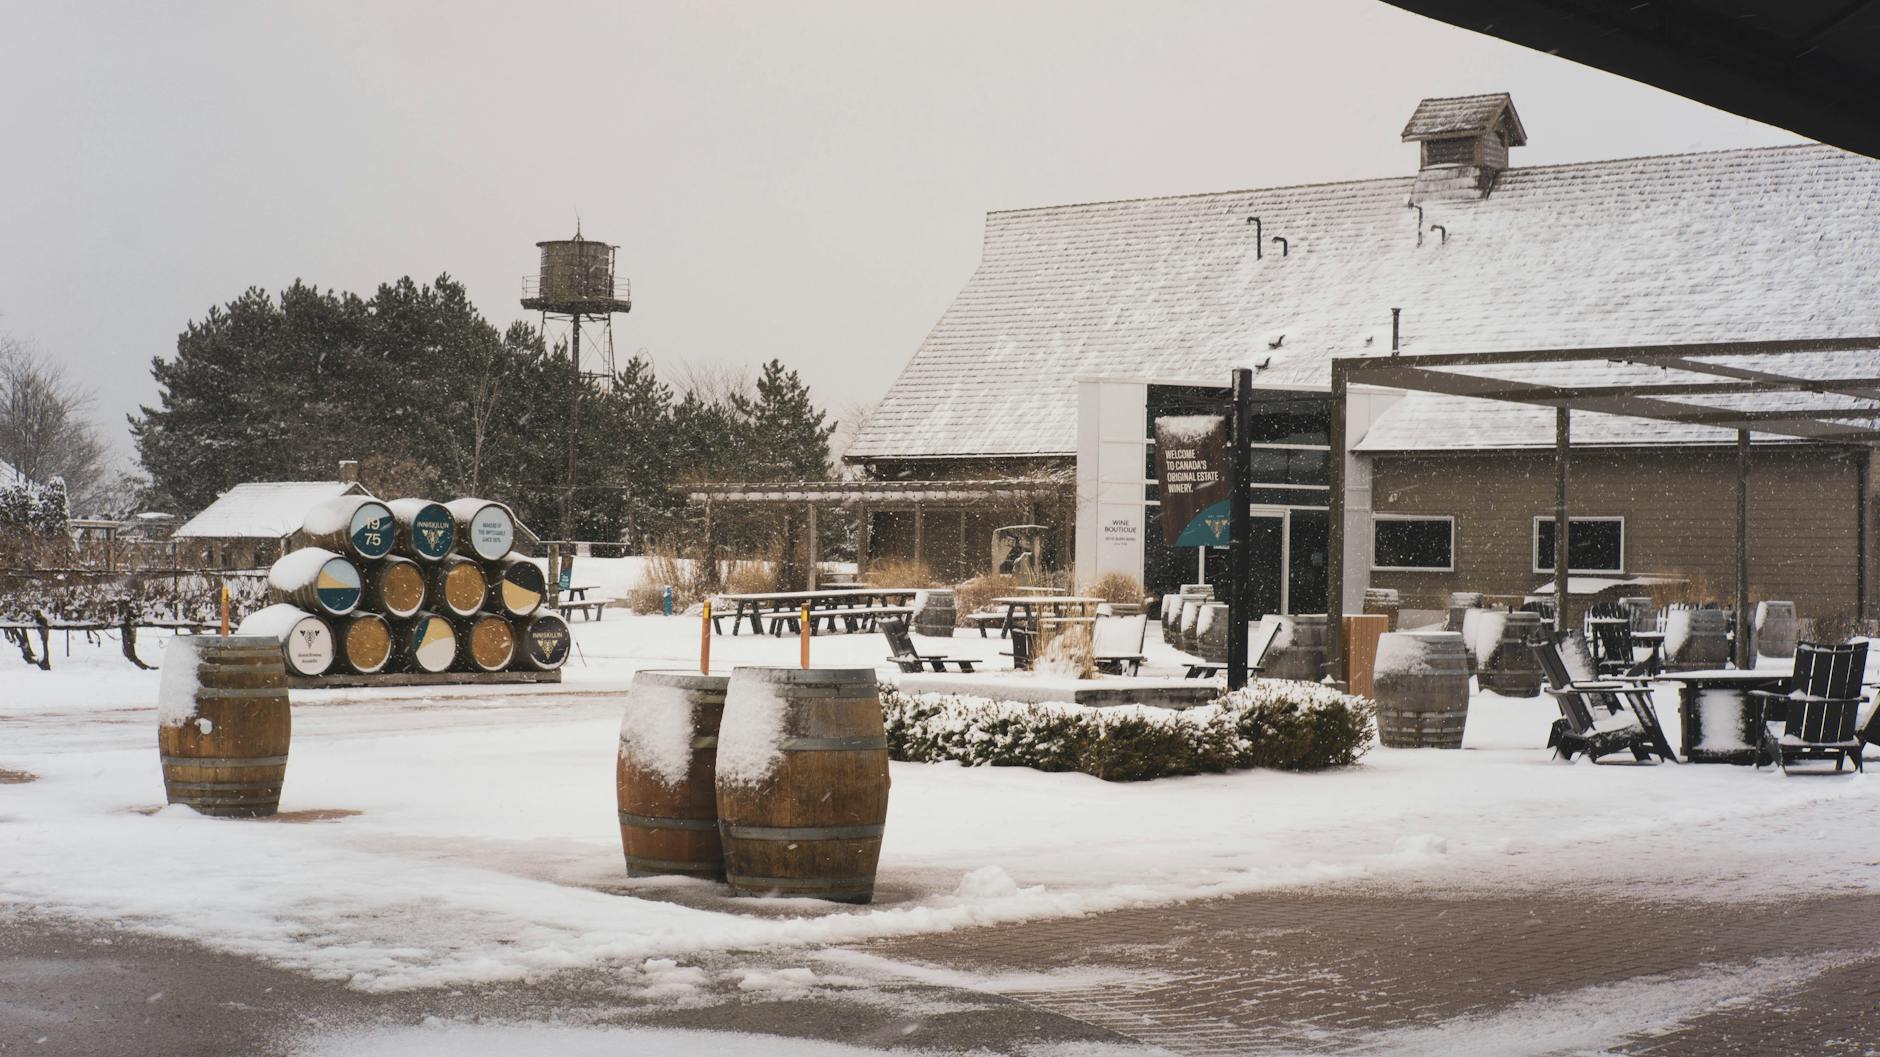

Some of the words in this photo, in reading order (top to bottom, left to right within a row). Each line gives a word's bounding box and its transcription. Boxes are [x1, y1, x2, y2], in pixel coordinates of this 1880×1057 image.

[1165, 449, 1195, 459] WELCOME
[1166, 461, 1174, 471] TO
[1175, 460, 1207, 470] CANADA'S
[1167, 472, 1196, 482] ORIGINAL
[1197, 471, 1219, 481] ESTATE
[1168, 483, 1193, 493] WINERY.
[366, 518, 380, 530] 19
[416, 521, 449, 529] INNISKILLIN
[364, 533, 381, 546] 75
